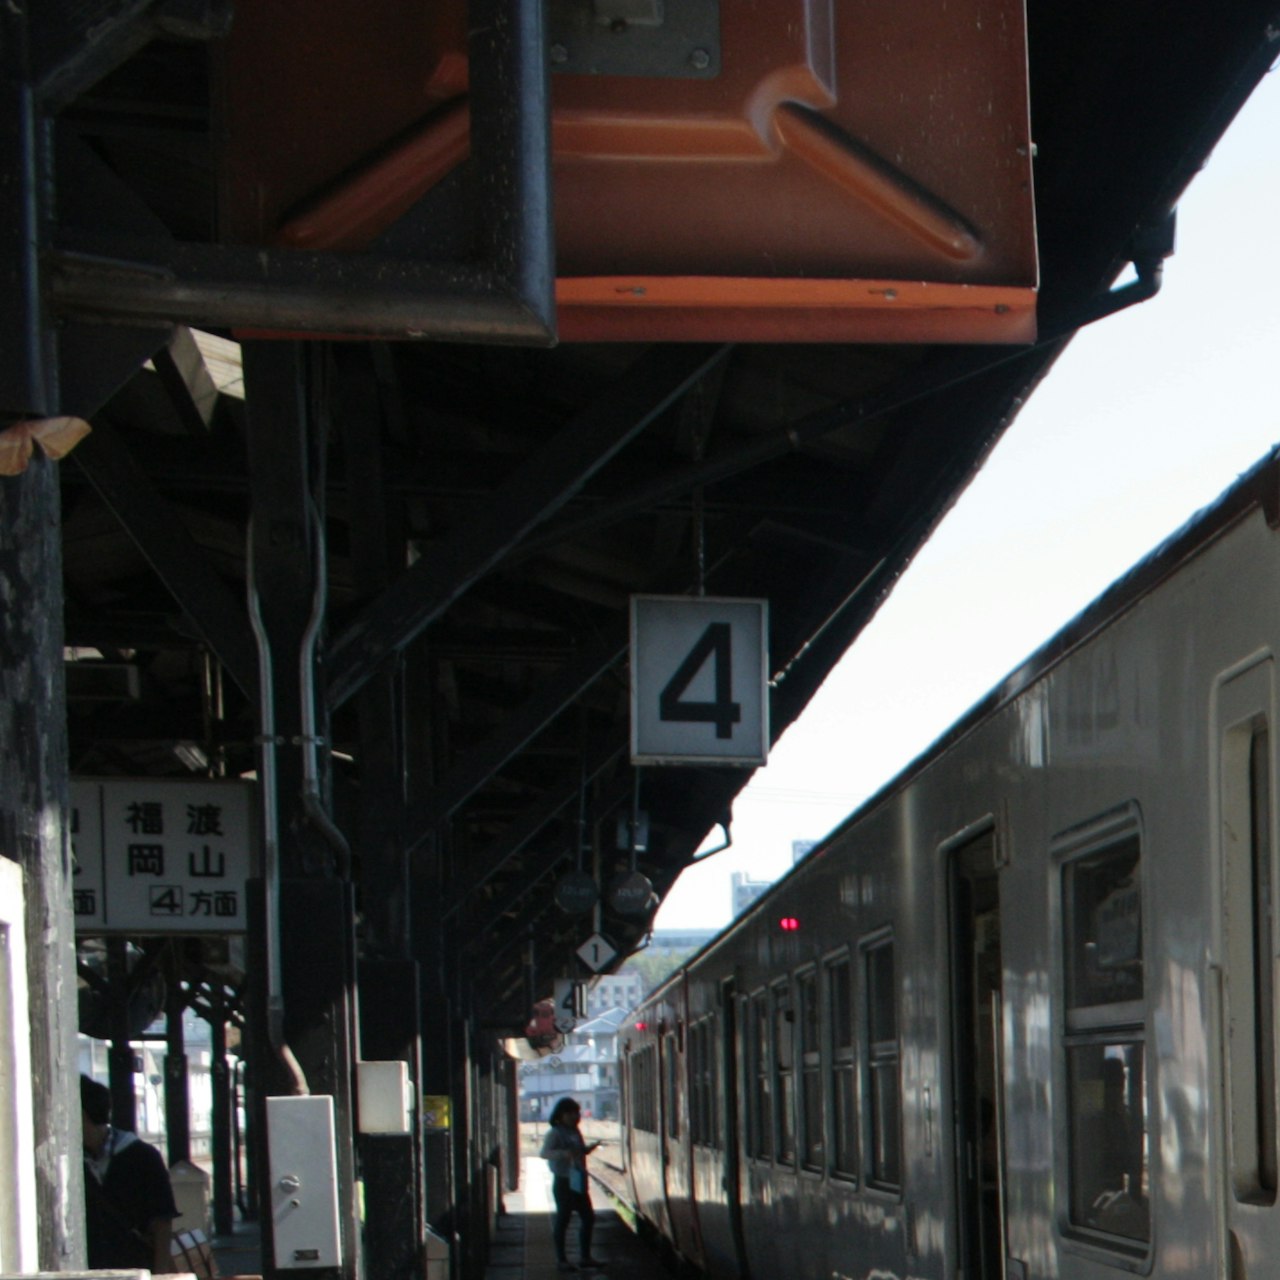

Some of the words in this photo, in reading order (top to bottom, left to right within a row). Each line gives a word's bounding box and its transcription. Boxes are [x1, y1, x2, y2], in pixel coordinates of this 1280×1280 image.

[659, 622, 741, 740] 4
[125, 802, 223, 837] 福渡
[128, 844, 225, 877] 岡山
[189, 890, 238, 917] 方面
[591, 943, 600, 963] 1
